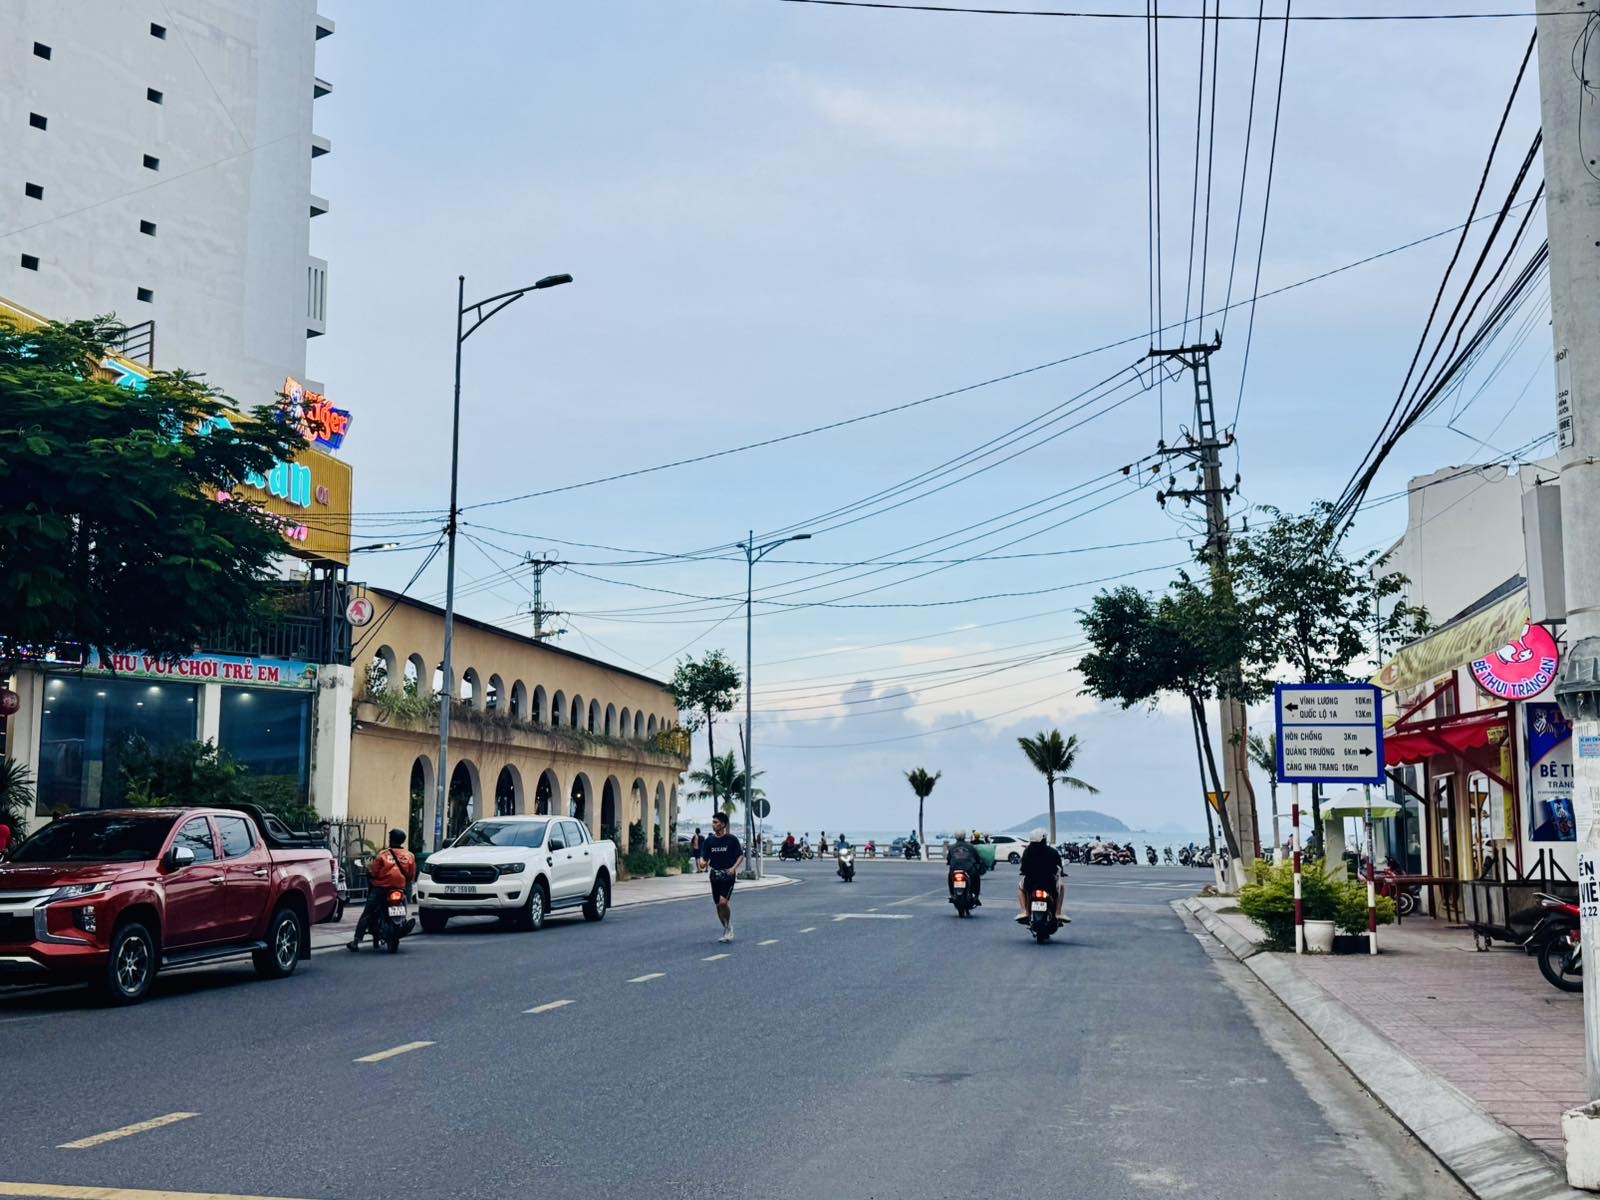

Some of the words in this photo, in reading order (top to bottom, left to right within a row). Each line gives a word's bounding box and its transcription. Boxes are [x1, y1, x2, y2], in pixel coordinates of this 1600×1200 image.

[178, 659, 218, 677] CHƠI
[223, 658, 254, 680] TRẺ
[258, 666, 280, 682] EM
[1481, 672, 1507, 695] THUI
[1541, 658, 1554, 675] AN
[1355, 697, 1372, 705] 10Km
[1300, 708, 1316, 719] QUỐC
[1319, 709, 1327, 720] LỘ
[1355, 710, 1372, 718] 13Km
[1344, 733, 1358, 741] 3Km
[1344, 748, 1358, 756] 6Km
[1304, 763, 1317, 771] NHA
[1319, 763, 1339, 771] TRANG
[1342, 763, 1359, 771] 10Km
[1540, 761, 1557, 777] BÊ
[1561, 764, 1574, 777] T
